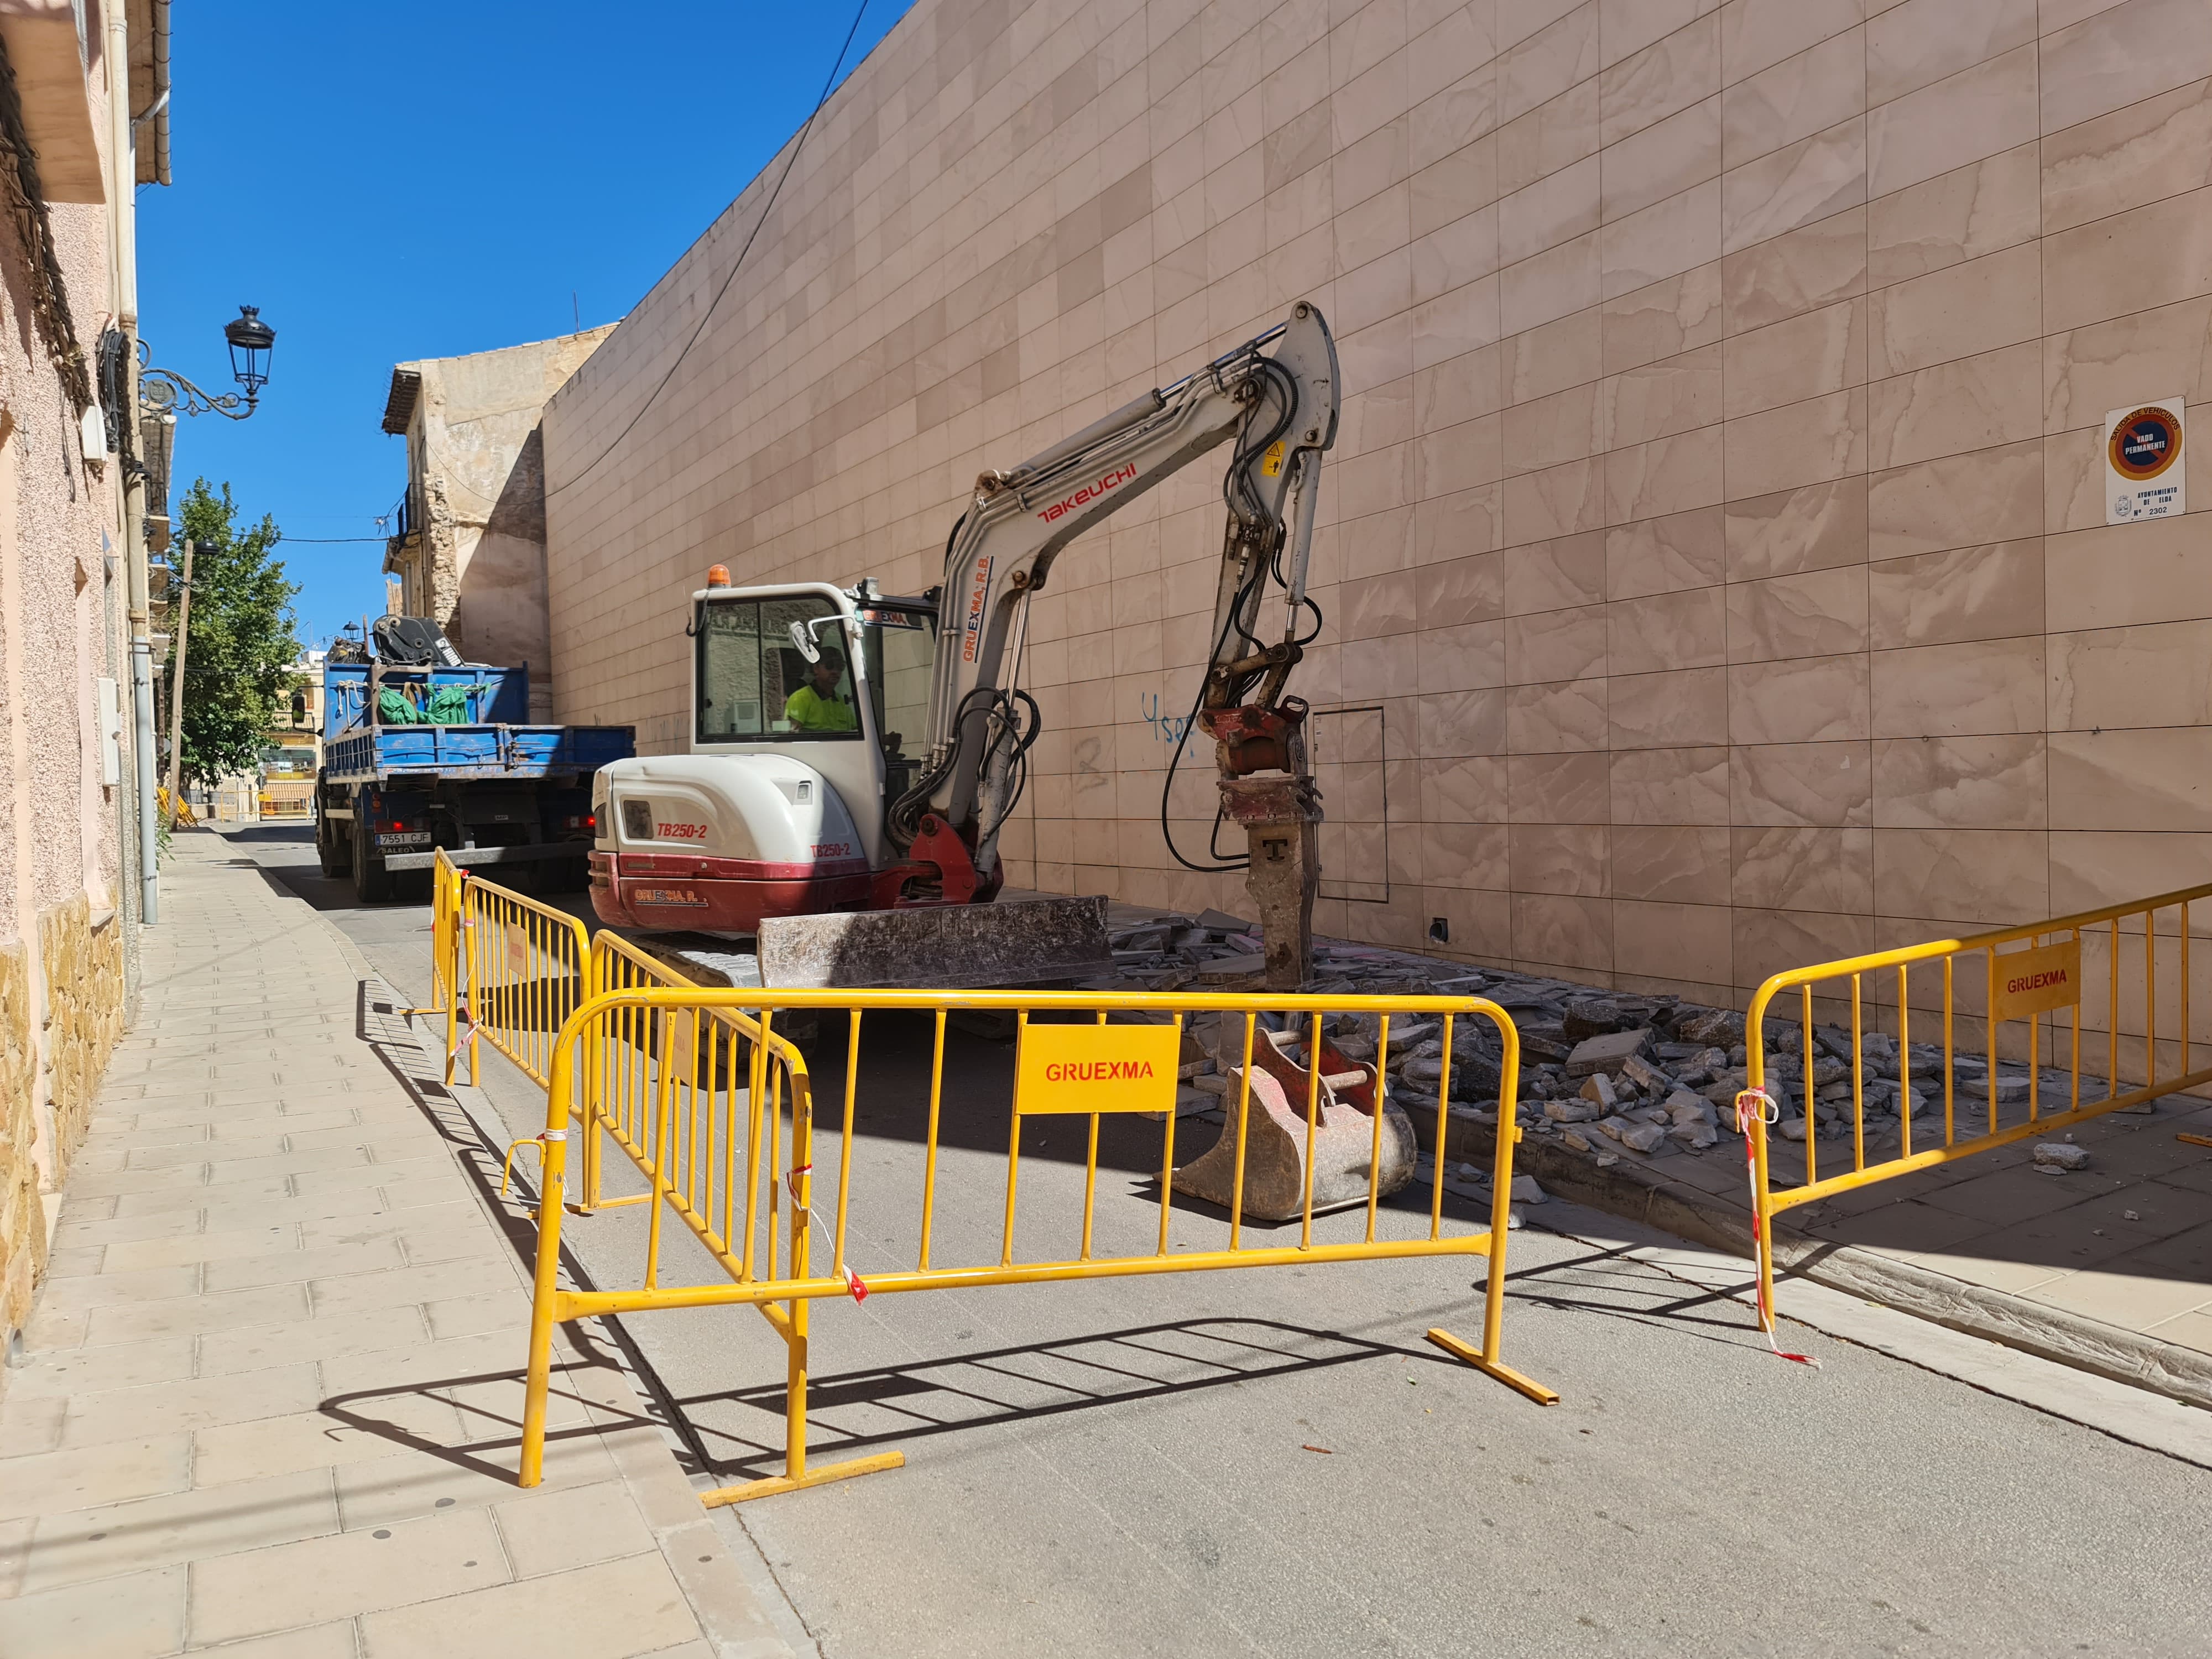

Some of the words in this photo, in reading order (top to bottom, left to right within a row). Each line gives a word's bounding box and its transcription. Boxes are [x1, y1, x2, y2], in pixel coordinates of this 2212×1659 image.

[2111, 416, 2131, 441] SALIDA
[2131, 410, 2142, 418] DE
[2143, 407, 2180, 430] VEHICULOS
[2136, 434, 2153, 444] VADO
[2125, 440, 2166, 455] PERMANENTE
[2137, 487, 2177, 499] AYUNTAMIENTO
[2149, 507, 2167, 515] 2302
[383, 834, 405, 843] 7551
[411, 833, 429, 842] CJF
[658, 823, 707, 838] TB250-2
[810, 843, 851, 858] TB250-2
[2008, 969, 2067, 994] GRUEXMA
[1046, 1061, 1154, 1081] GRUEXMA
